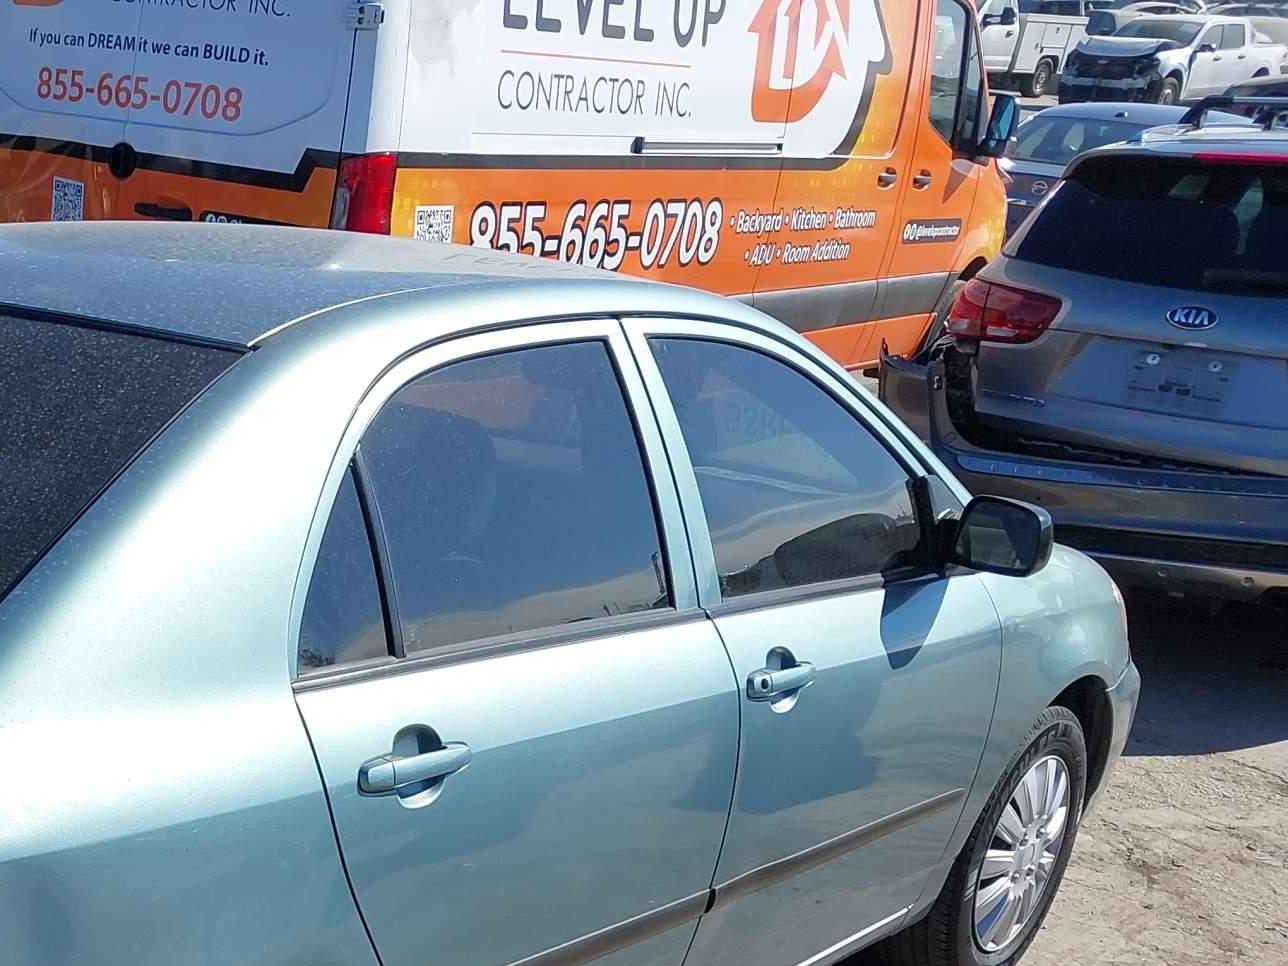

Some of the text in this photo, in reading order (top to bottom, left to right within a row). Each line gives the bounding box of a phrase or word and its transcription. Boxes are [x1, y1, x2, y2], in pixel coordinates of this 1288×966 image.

[673, 0, 726, 48] UP
[29, 27, 269, 66] If you can DREAM it we can BUILD it.
[37, 66, 242, 121] 855-665-0708
[497, 69, 692, 118] CONTRACTOR INC.
[470, 198, 723, 271] 855-665-0708
[736, 206, 876, 236] Backyard Kitchen Bathroom
[750, 239, 851, 266] ADU Room Addition
[1173, 308, 1210, 326] KIA
